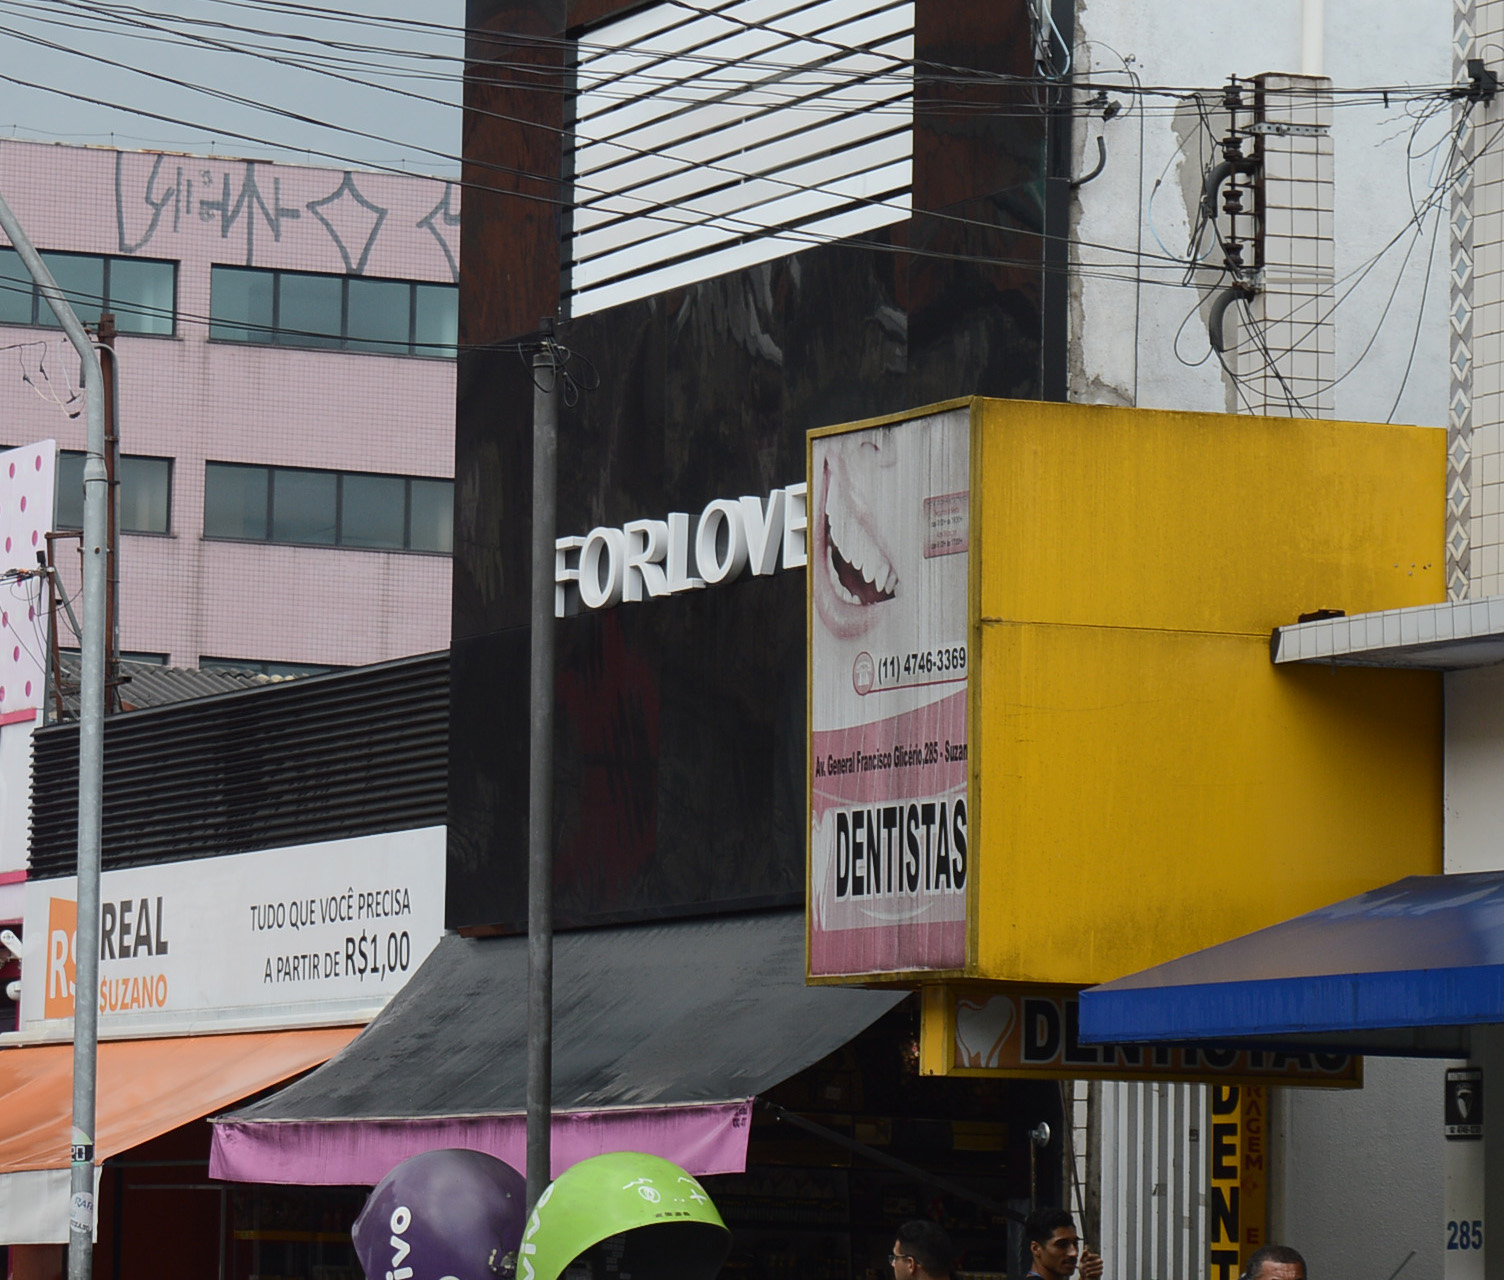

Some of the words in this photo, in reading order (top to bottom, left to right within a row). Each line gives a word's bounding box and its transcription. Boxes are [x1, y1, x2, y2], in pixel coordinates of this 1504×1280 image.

[555, 482, 807, 618] FORLOVE
[878, 656, 900, 684] (11)
[903, 646, 966, 675] 4746-3369
[816, 756, 826, 778] Av.
[828, 750, 855, 776] General
[857, 748, 891, 774] Francisco
[836, 799, 967, 898] DENTISTAS
[100, 896, 169, 961] REAL
[250, 902, 286, 932] TUDO
[289, 899, 316, 931] QUE
[320, 886, 354, 924] VOCÊ
[358, 888, 411, 920] PRECISA
[264, 957, 273, 984] A
[277, 953, 320, 983] PARTIR
[324, 951, 340, 979] DE
[345, 929, 410, 982] R$1,00
[1447, 1220, 1483, 1250] 285
